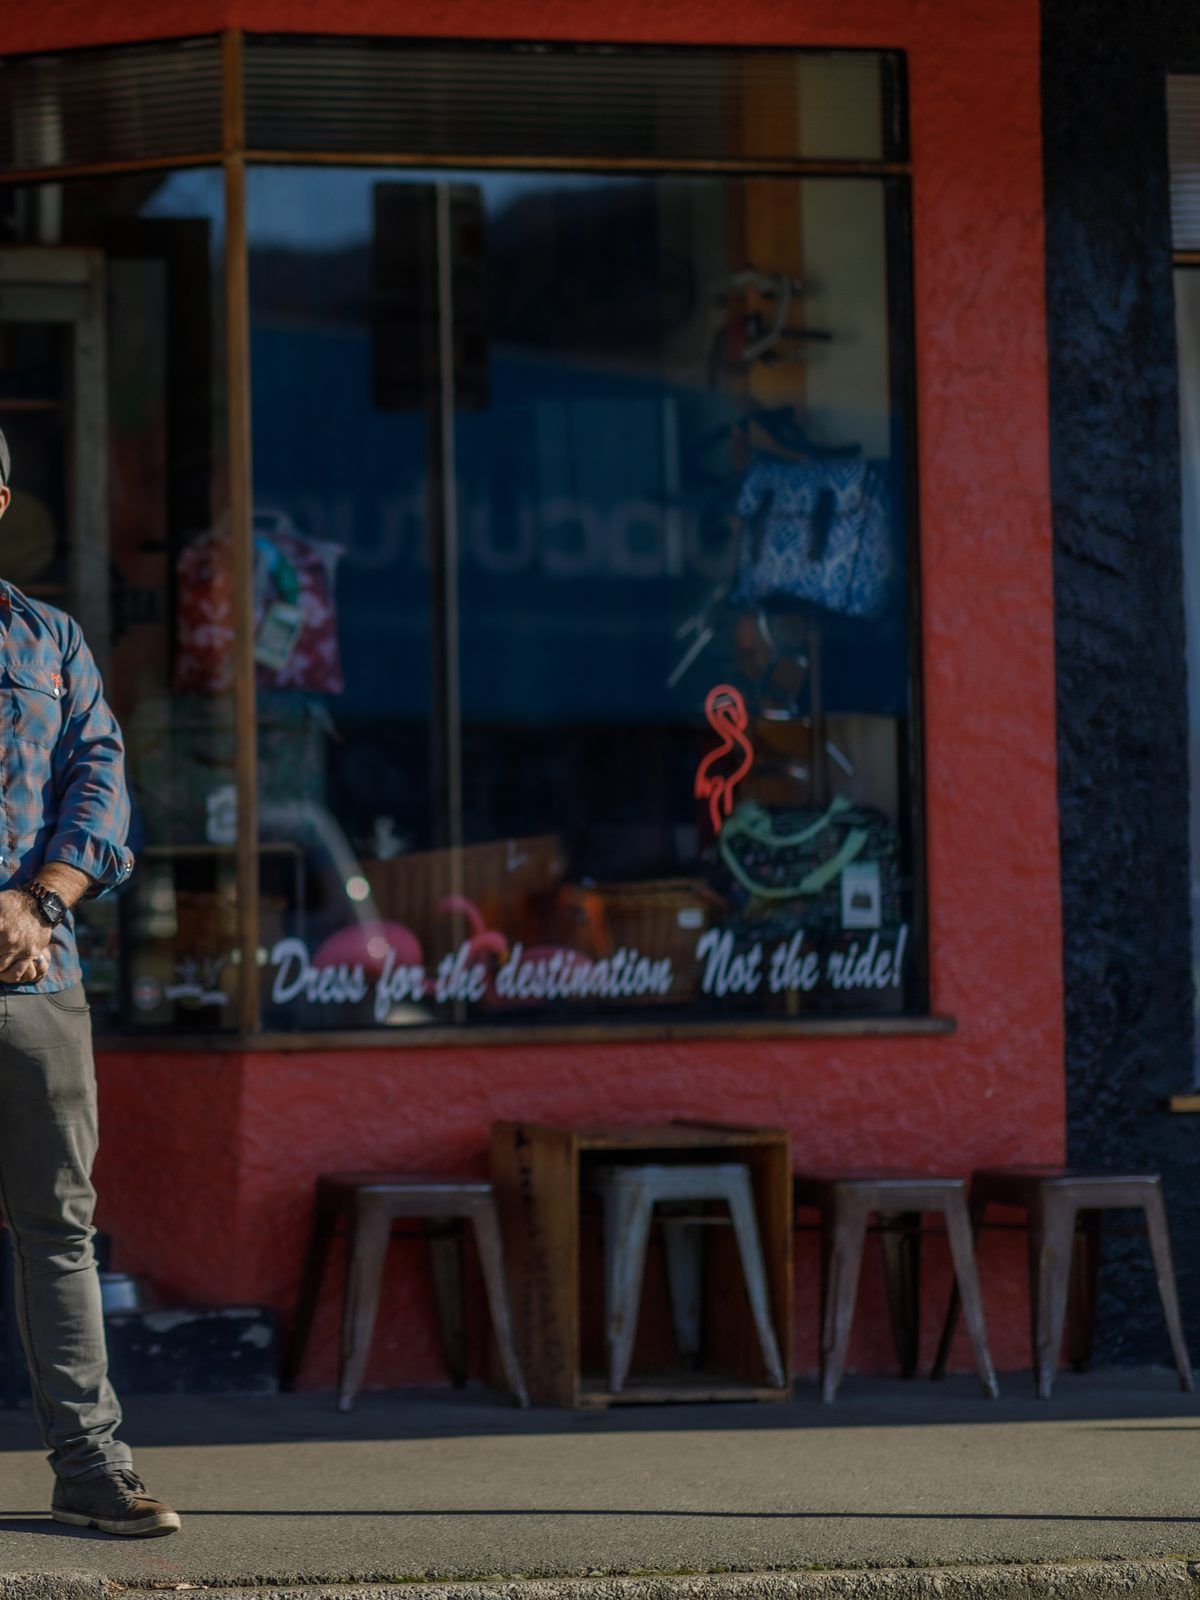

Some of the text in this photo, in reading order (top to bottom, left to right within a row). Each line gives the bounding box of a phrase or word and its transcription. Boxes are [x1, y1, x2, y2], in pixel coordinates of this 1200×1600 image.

[270, 937, 368, 1004] Dress
[373, 949, 427, 1024] for
[436, 940, 488, 1003] the
[495, 941, 674, 1000] destination
[696, 926, 764, 998] Not
[768, 929, 821, 994] the
[826, 922, 909, 990] ride!
